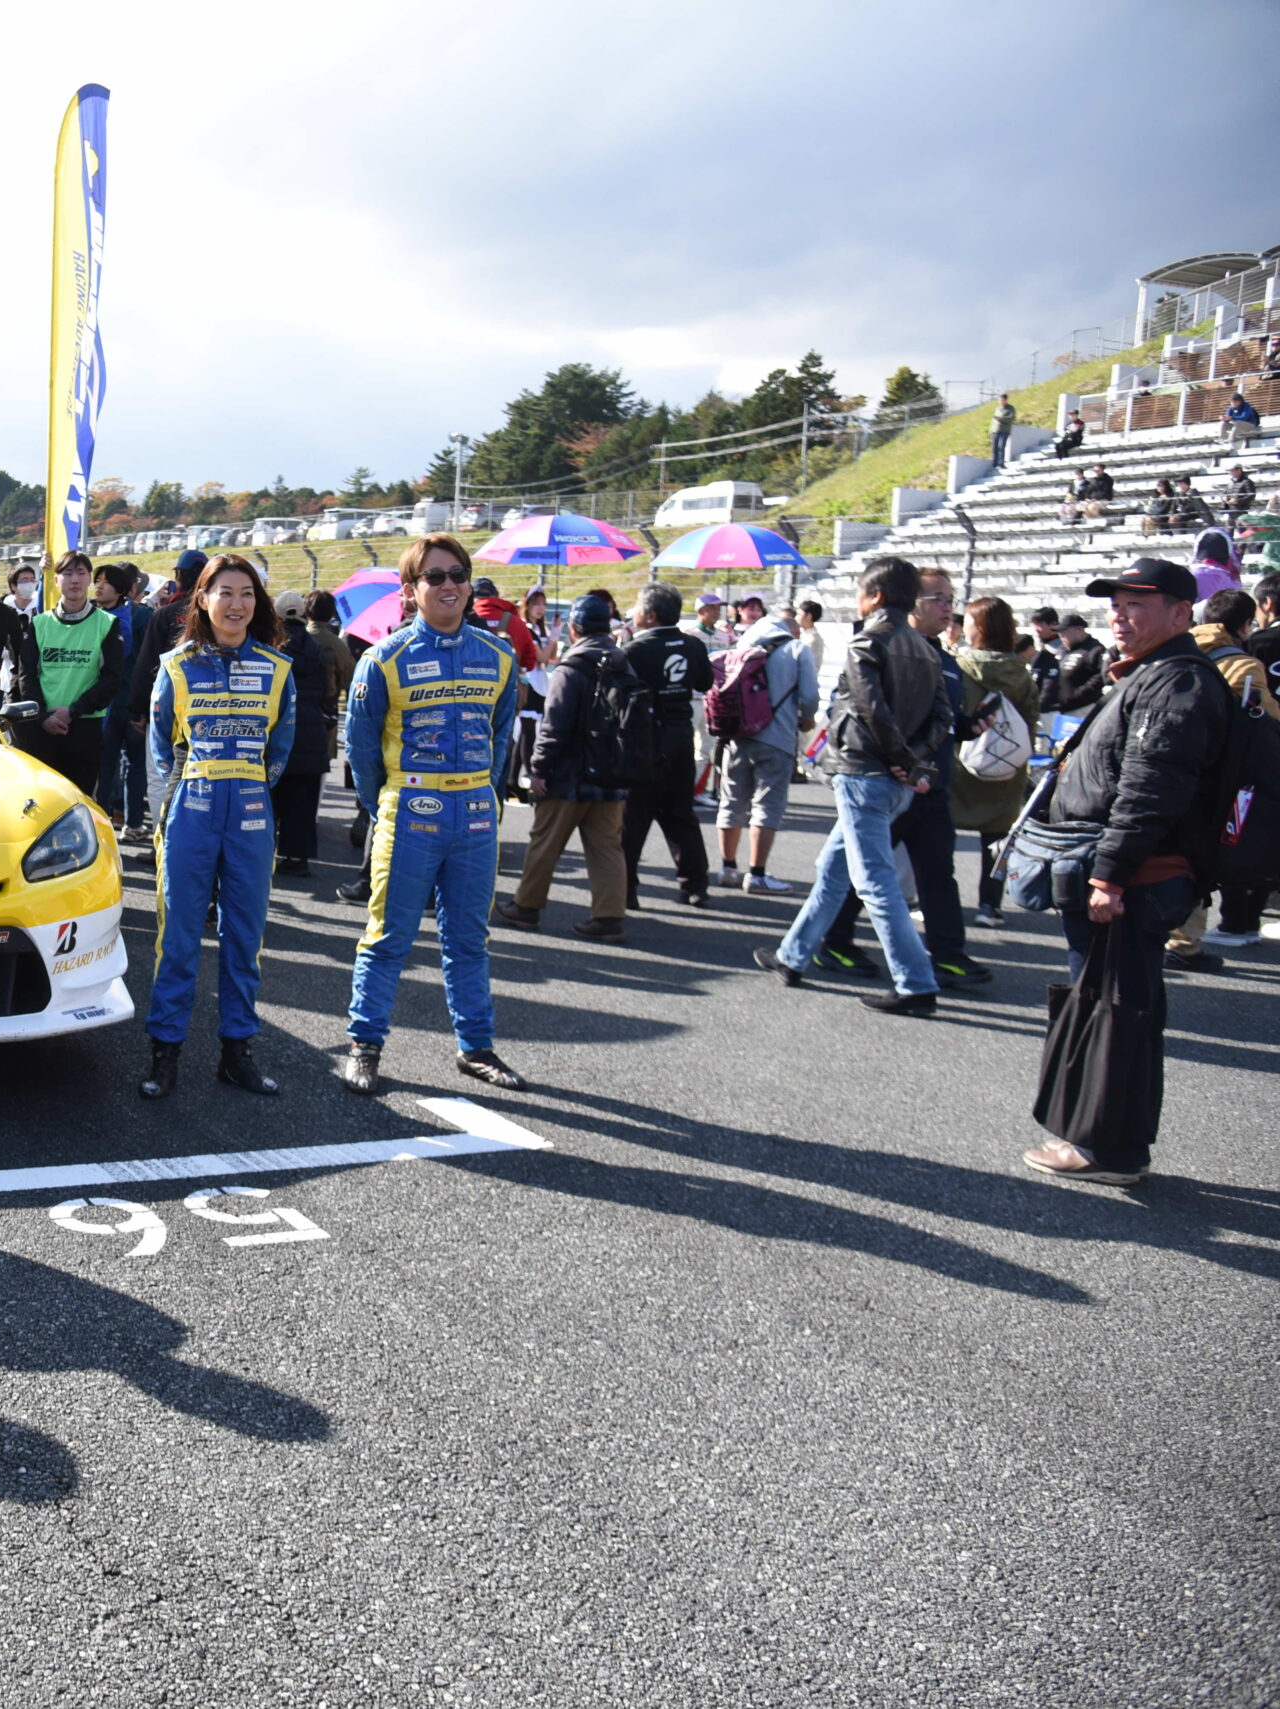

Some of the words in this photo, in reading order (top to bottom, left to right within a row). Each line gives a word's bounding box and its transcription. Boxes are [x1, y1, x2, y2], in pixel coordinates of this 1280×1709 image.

[60, 647, 93, 657] Super
[408, 685, 495, 703] WedsSport
[190, 698, 269, 709] WedsSport
[209, 725, 265, 738] GoTake
[52, 951, 94, 975] HAZARD
